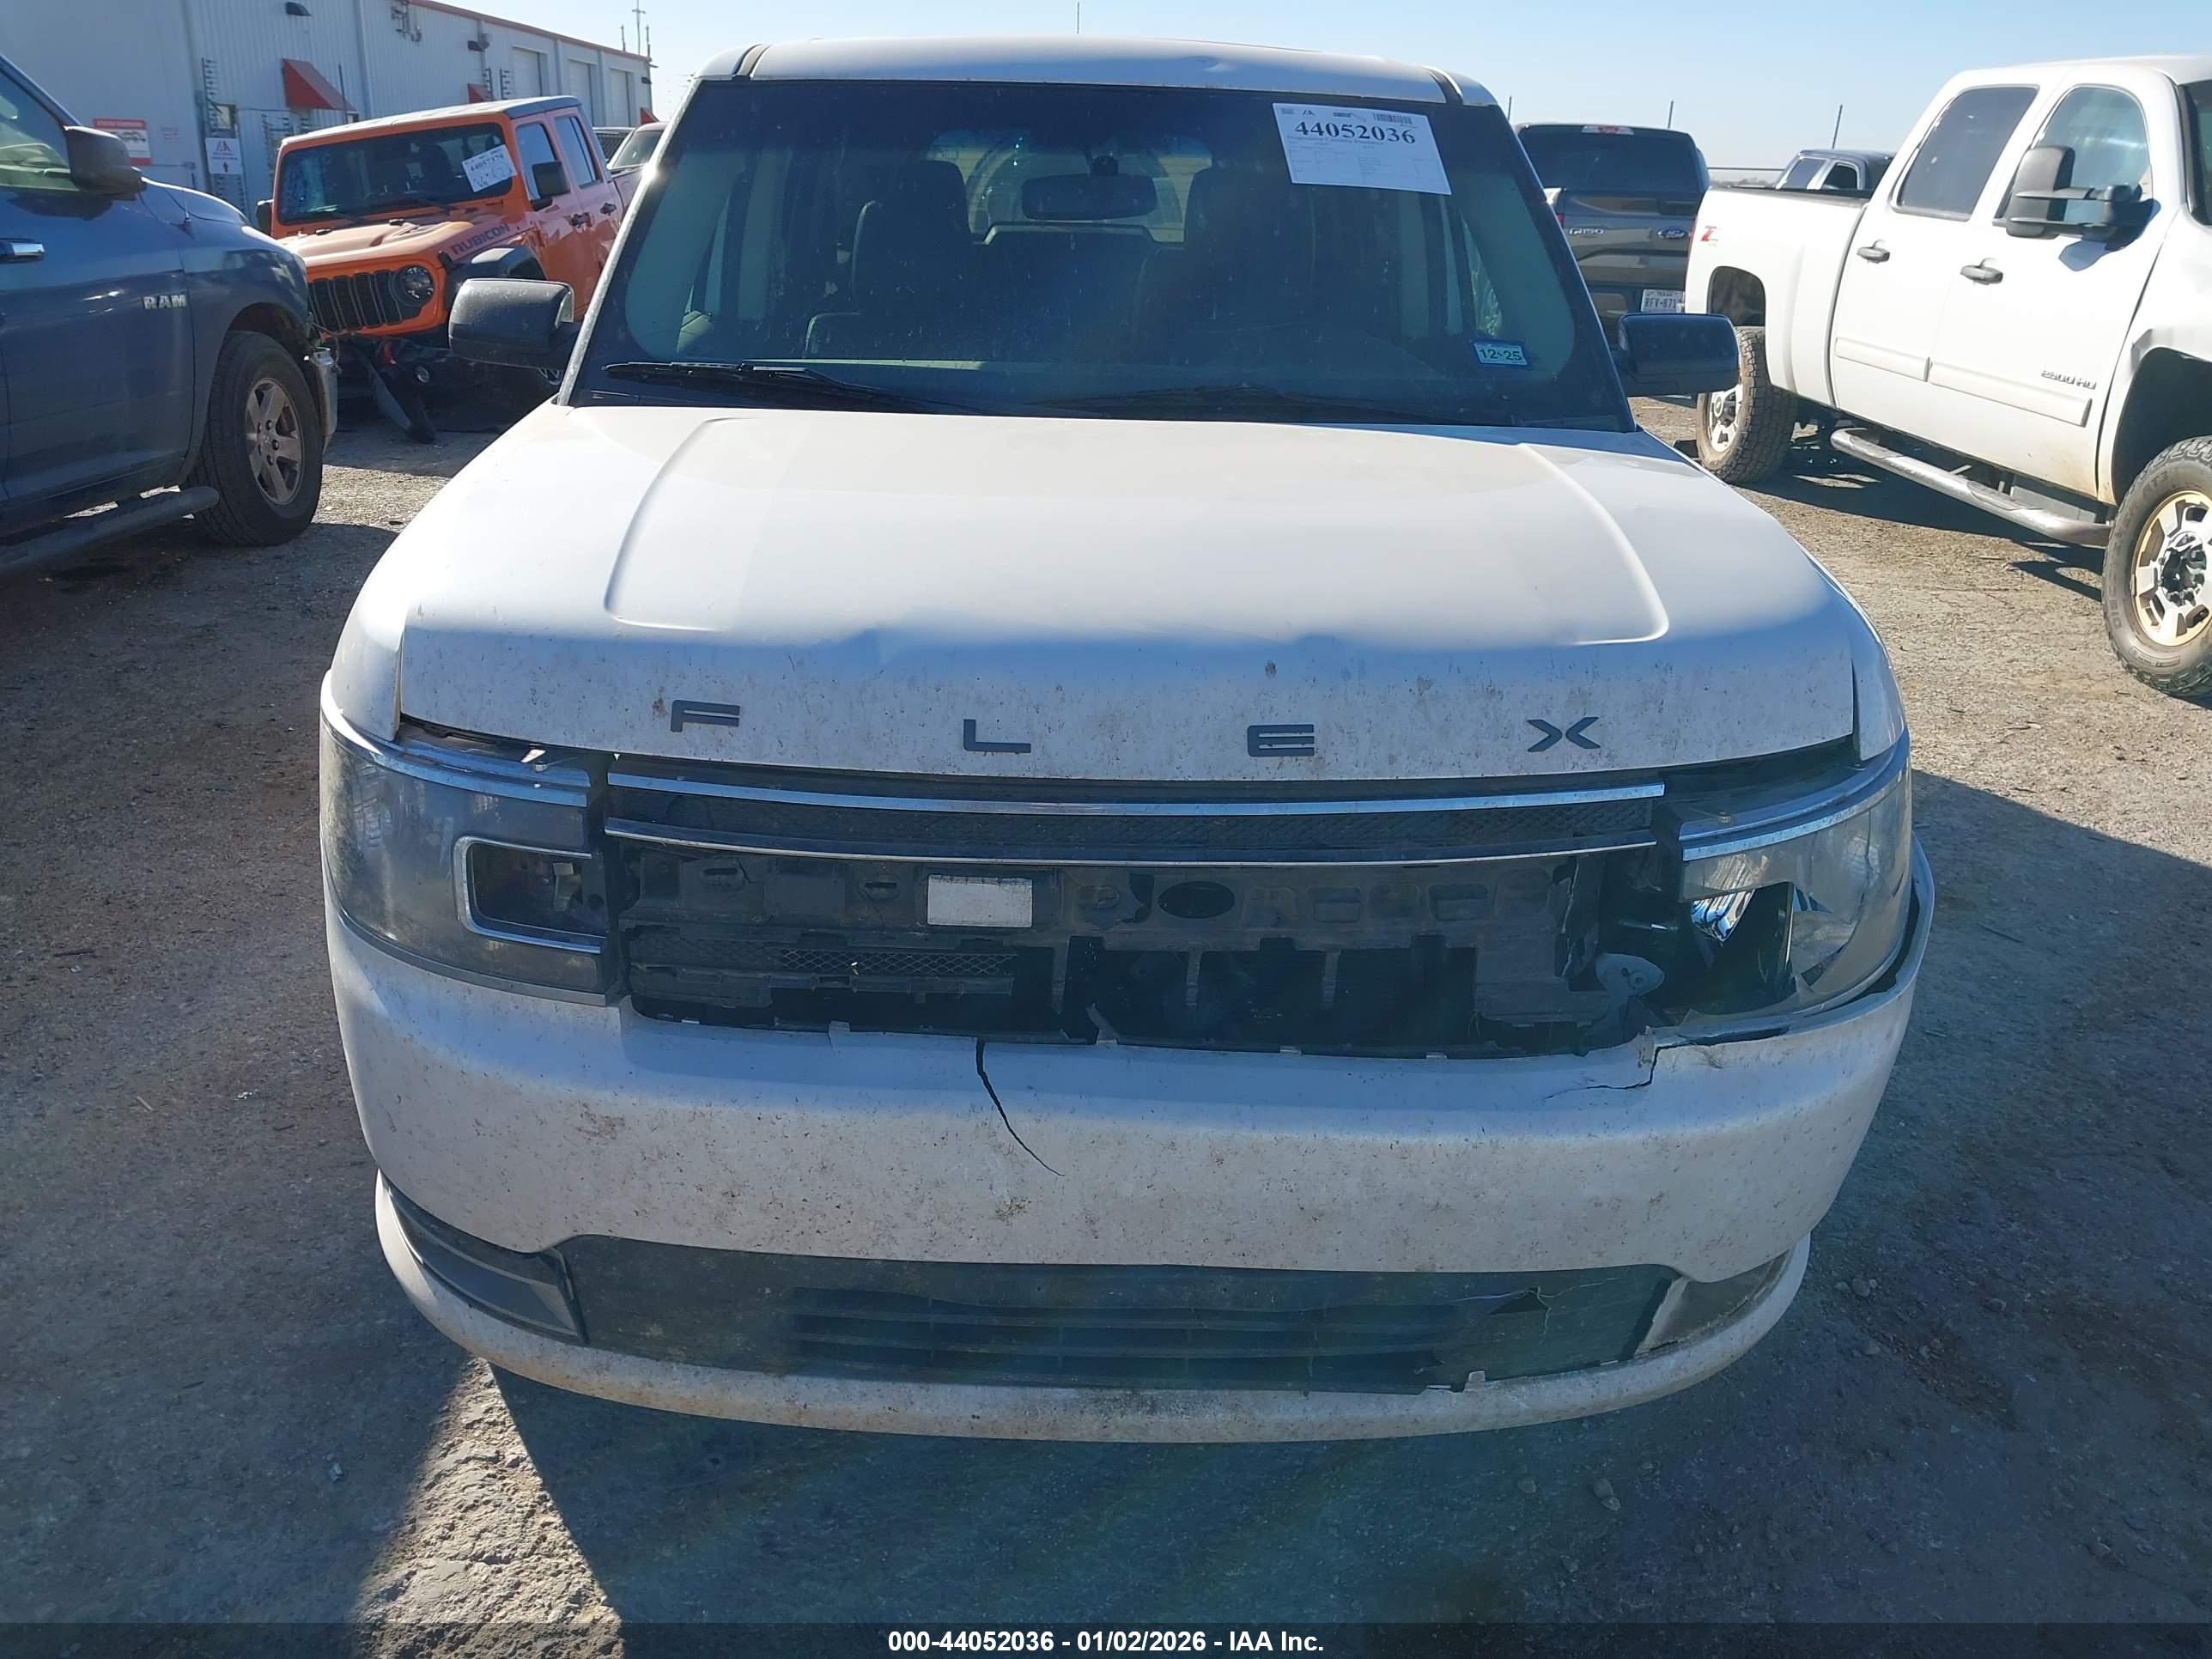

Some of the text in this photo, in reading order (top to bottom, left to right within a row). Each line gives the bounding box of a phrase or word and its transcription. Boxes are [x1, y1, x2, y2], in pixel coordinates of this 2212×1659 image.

[1296, 120, 1416, 145] 44052036
[451, 223, 510, 255] RUBICON
[143, 295, 187, 309] RAM
